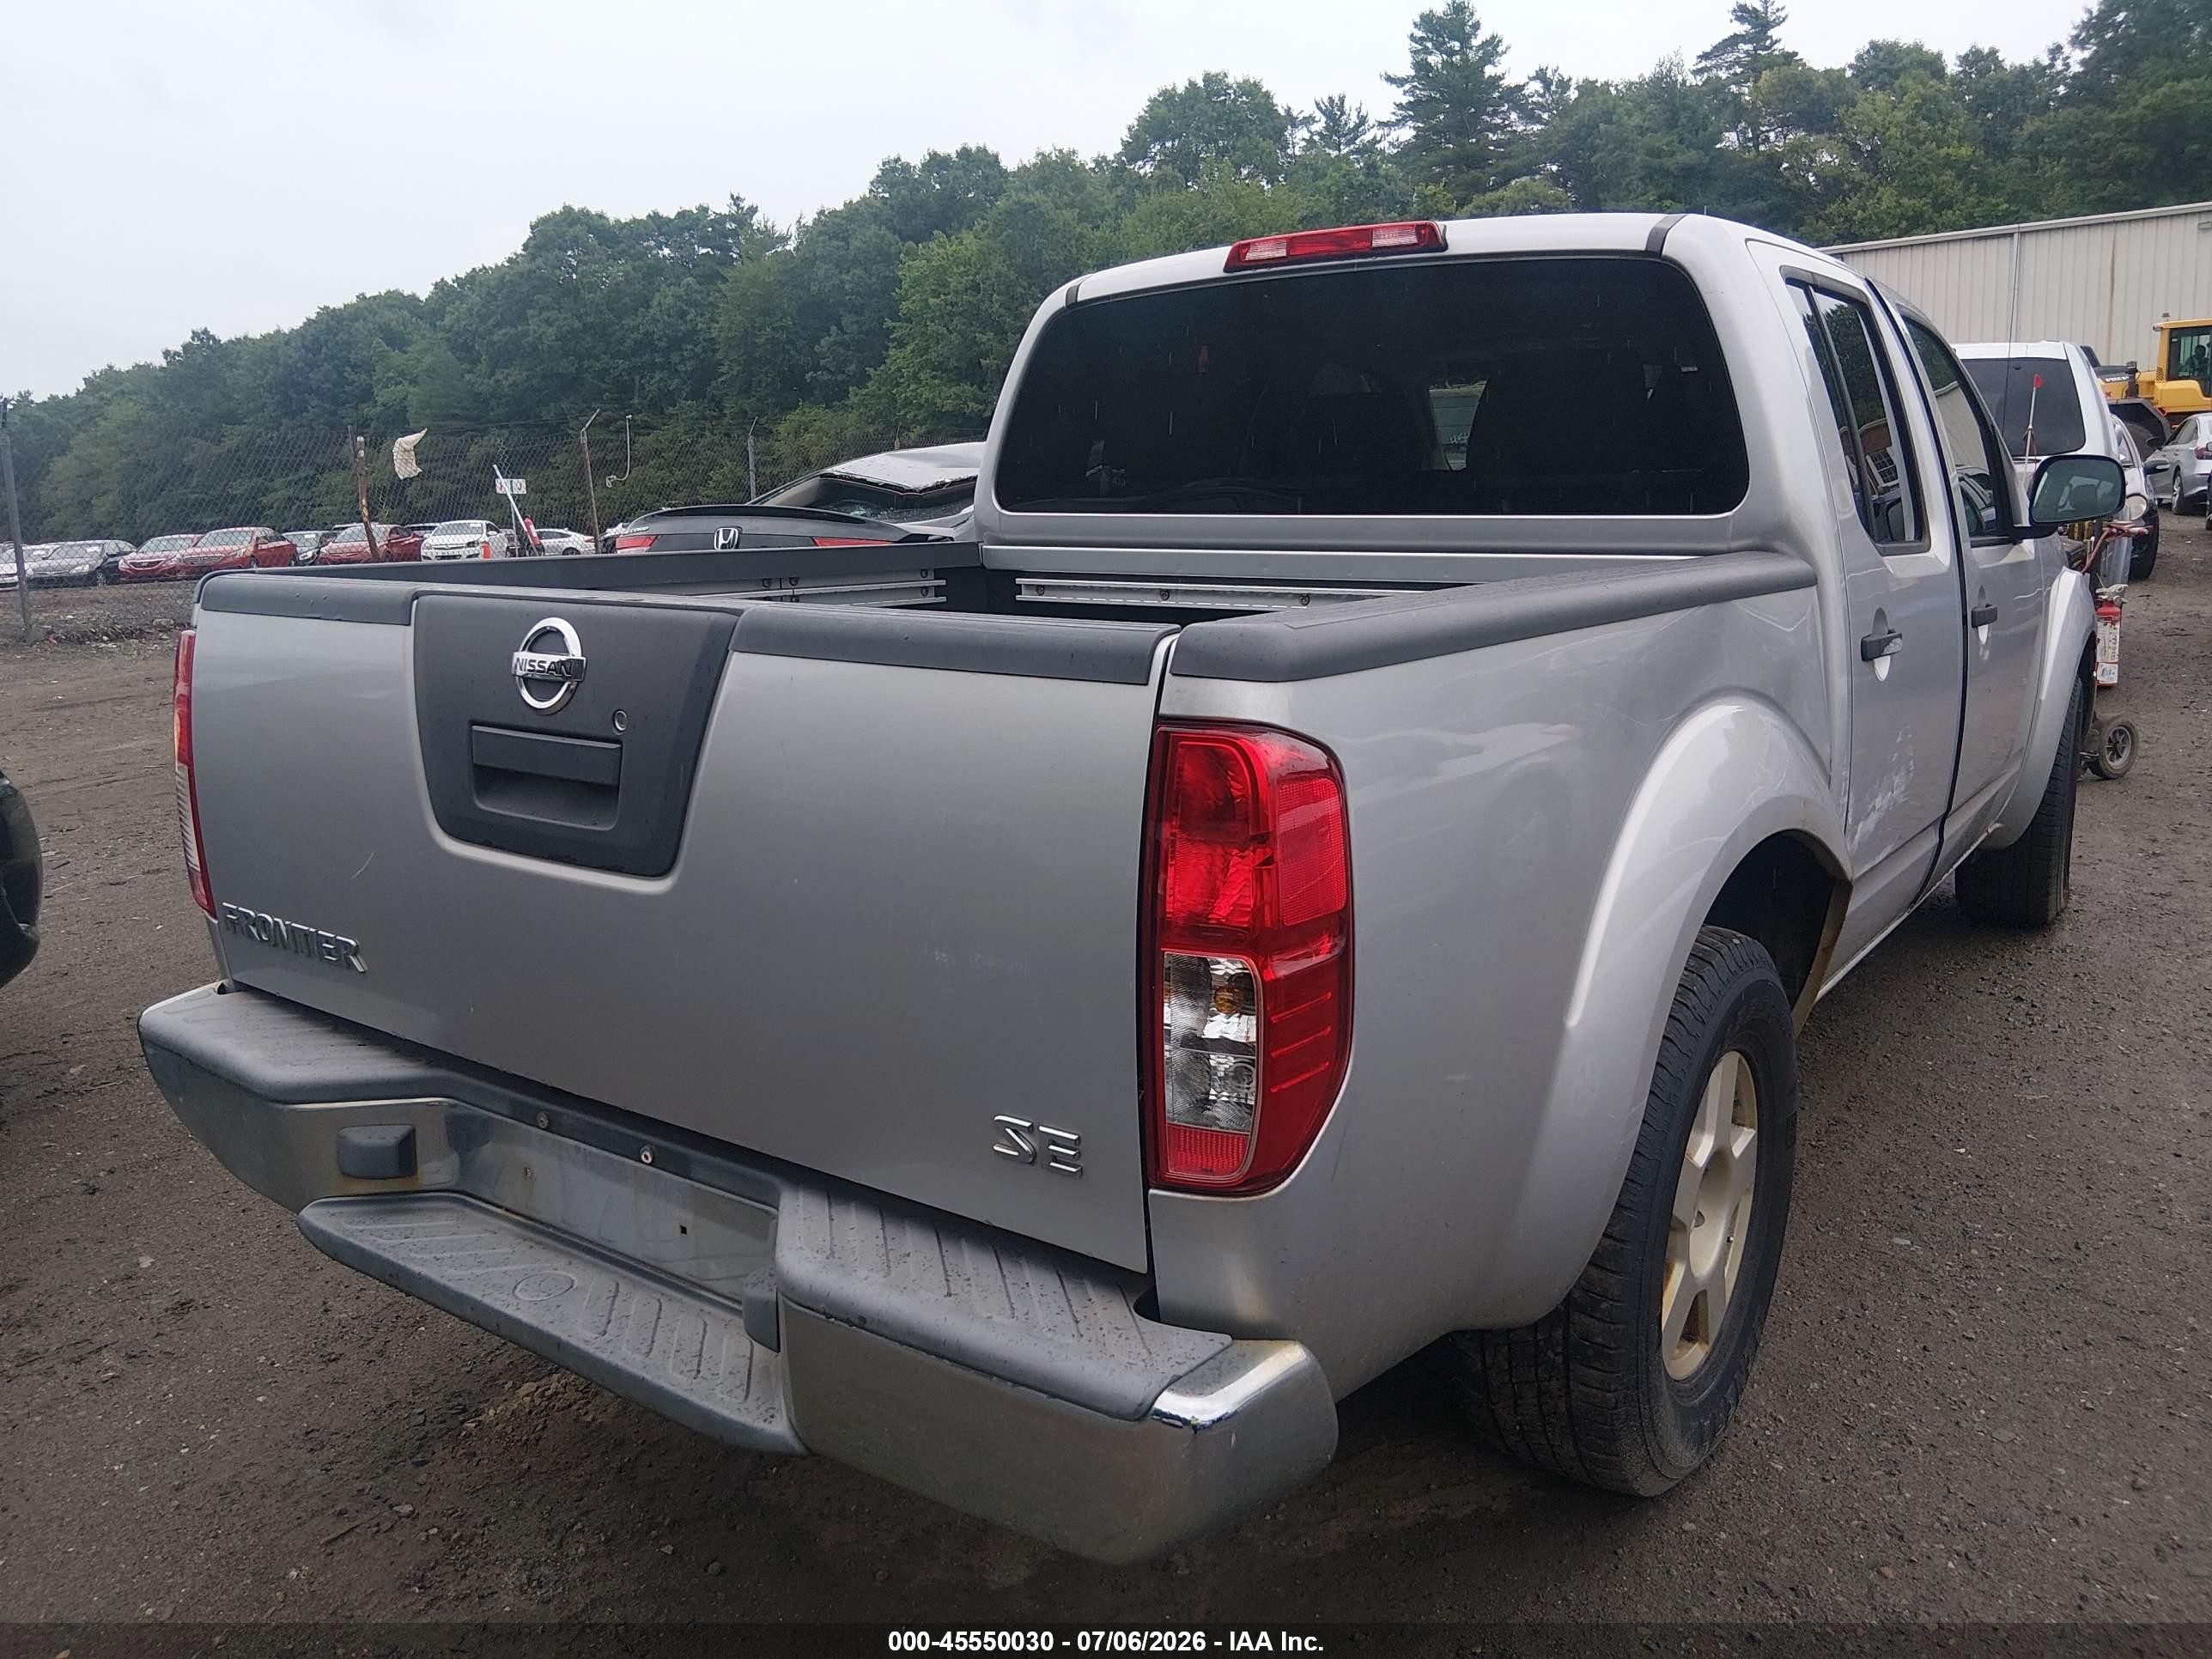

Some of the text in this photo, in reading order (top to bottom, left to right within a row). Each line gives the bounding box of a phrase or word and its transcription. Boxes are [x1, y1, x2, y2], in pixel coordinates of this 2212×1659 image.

[515, 657, 573, 677] NISSAN
[222, 902, 367, 973] FRONTIER
[993, 1115, 1083, 1176] SE
